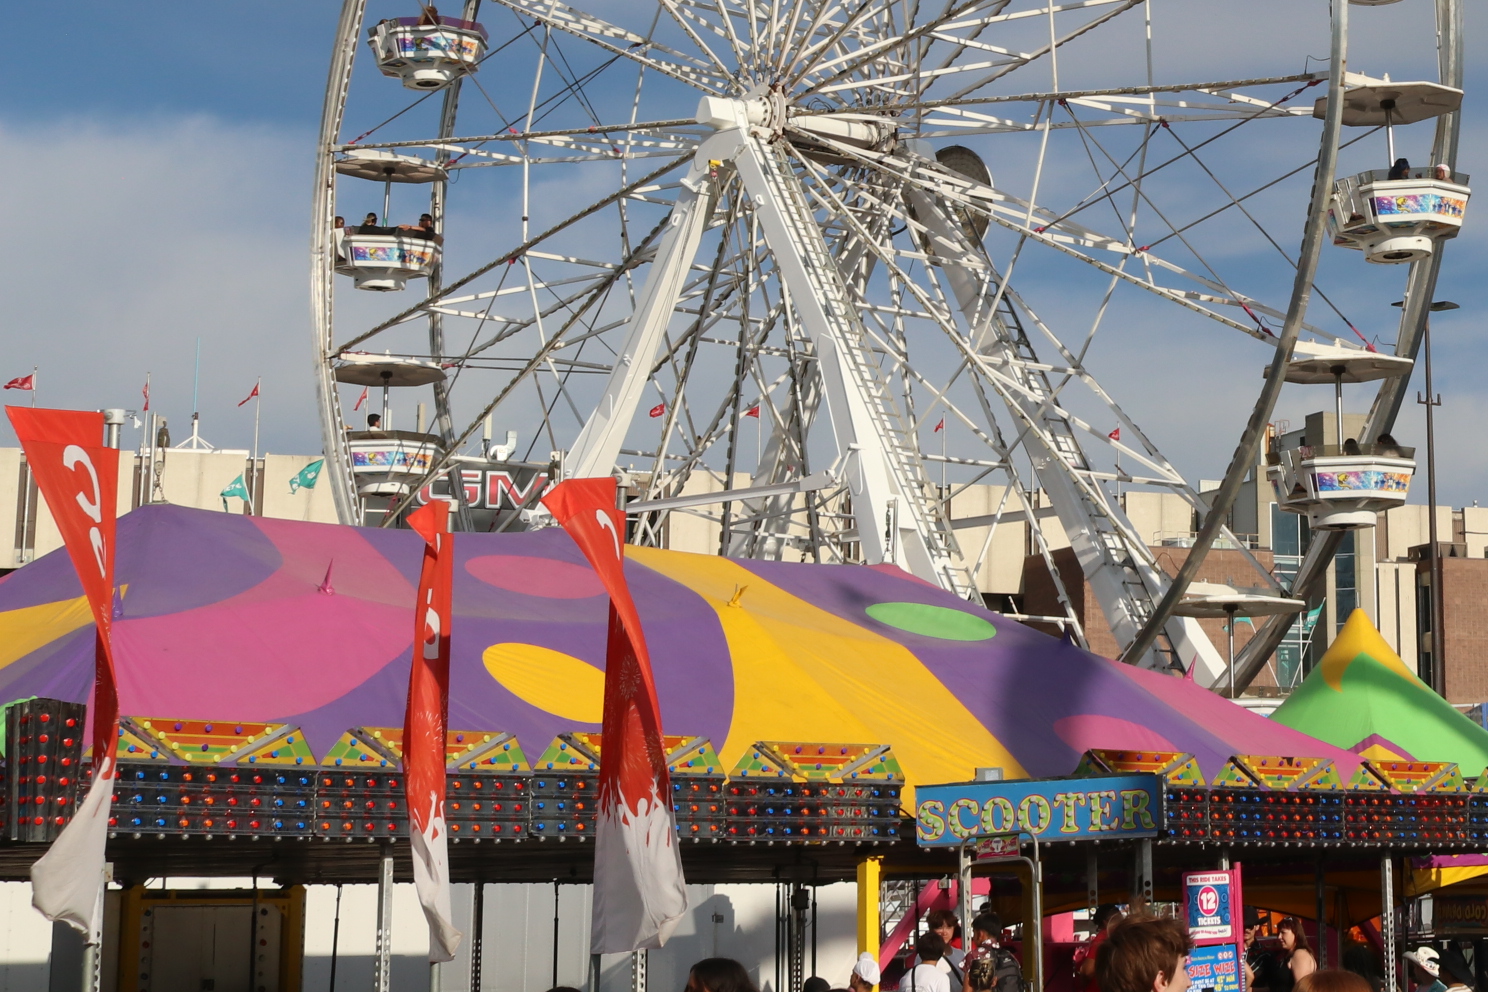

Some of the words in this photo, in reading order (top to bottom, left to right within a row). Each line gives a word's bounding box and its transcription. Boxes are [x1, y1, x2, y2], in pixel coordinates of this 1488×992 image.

[917, 788, 1156, 841] SCOOTER
[1200, 891, 1216, 910] 12
[1198, 916, 1221, 926] TICKETS
[1188, 963, 1211, 978] SIZE
[1213, 960, 1235, 975] WIZE
